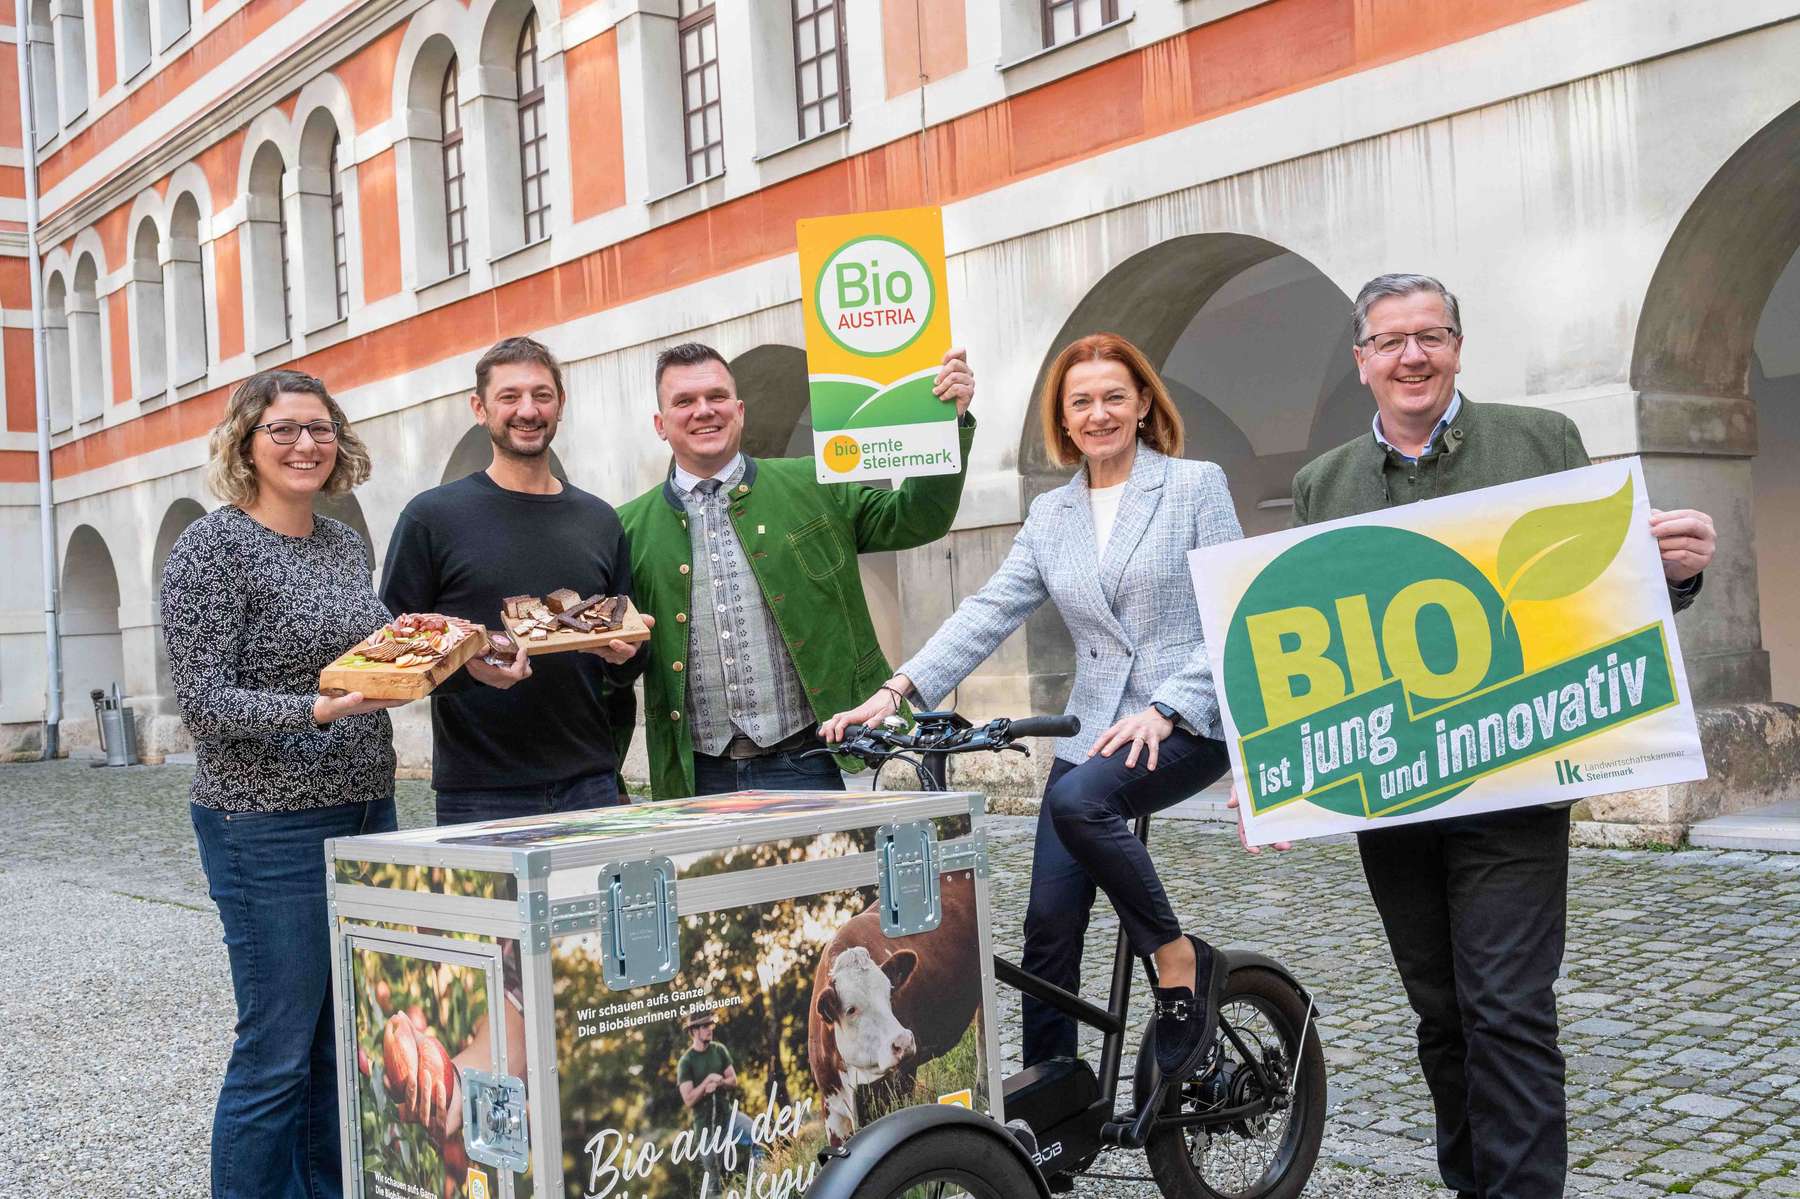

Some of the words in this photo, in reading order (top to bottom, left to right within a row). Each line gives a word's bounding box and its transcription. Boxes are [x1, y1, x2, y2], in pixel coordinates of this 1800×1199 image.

[836, 259, 913, 309] Bio
[838, 307, 916, 330] AUSTRIA
[863, 448, 952, 470] steiermark
[1245, 578, 1492, 727] BIO
[1380, 750, 1428, 800] und
[1435, 652, 1647, 779] innovativ
[1258, 756, 1292, 797] ist
[1300, 703, 1398, 794] jung
[1584, 750, 1685, 771] Landwirtschaftskammer
[1586, 767, 1634, 782] Steiermark
[577, 1008, 596, 1022] Wir
[599, 999, 644, 1018] schauen
[646, 992, 669, 1007] aufs
[671, 987, 706, 1002] Ganze.
[578, 1025, 597, 1038] Die
[599, 1008, 677, 1034] Biobäuerinnen
[679, 1005, 688, 1017] &
[689, 995, 744, 1015] Biobauern.
[584, 1127, 664, 1199] Bio
[671, 1099, 744, 1172] auf
[751, 1081, 812, 1144] der
